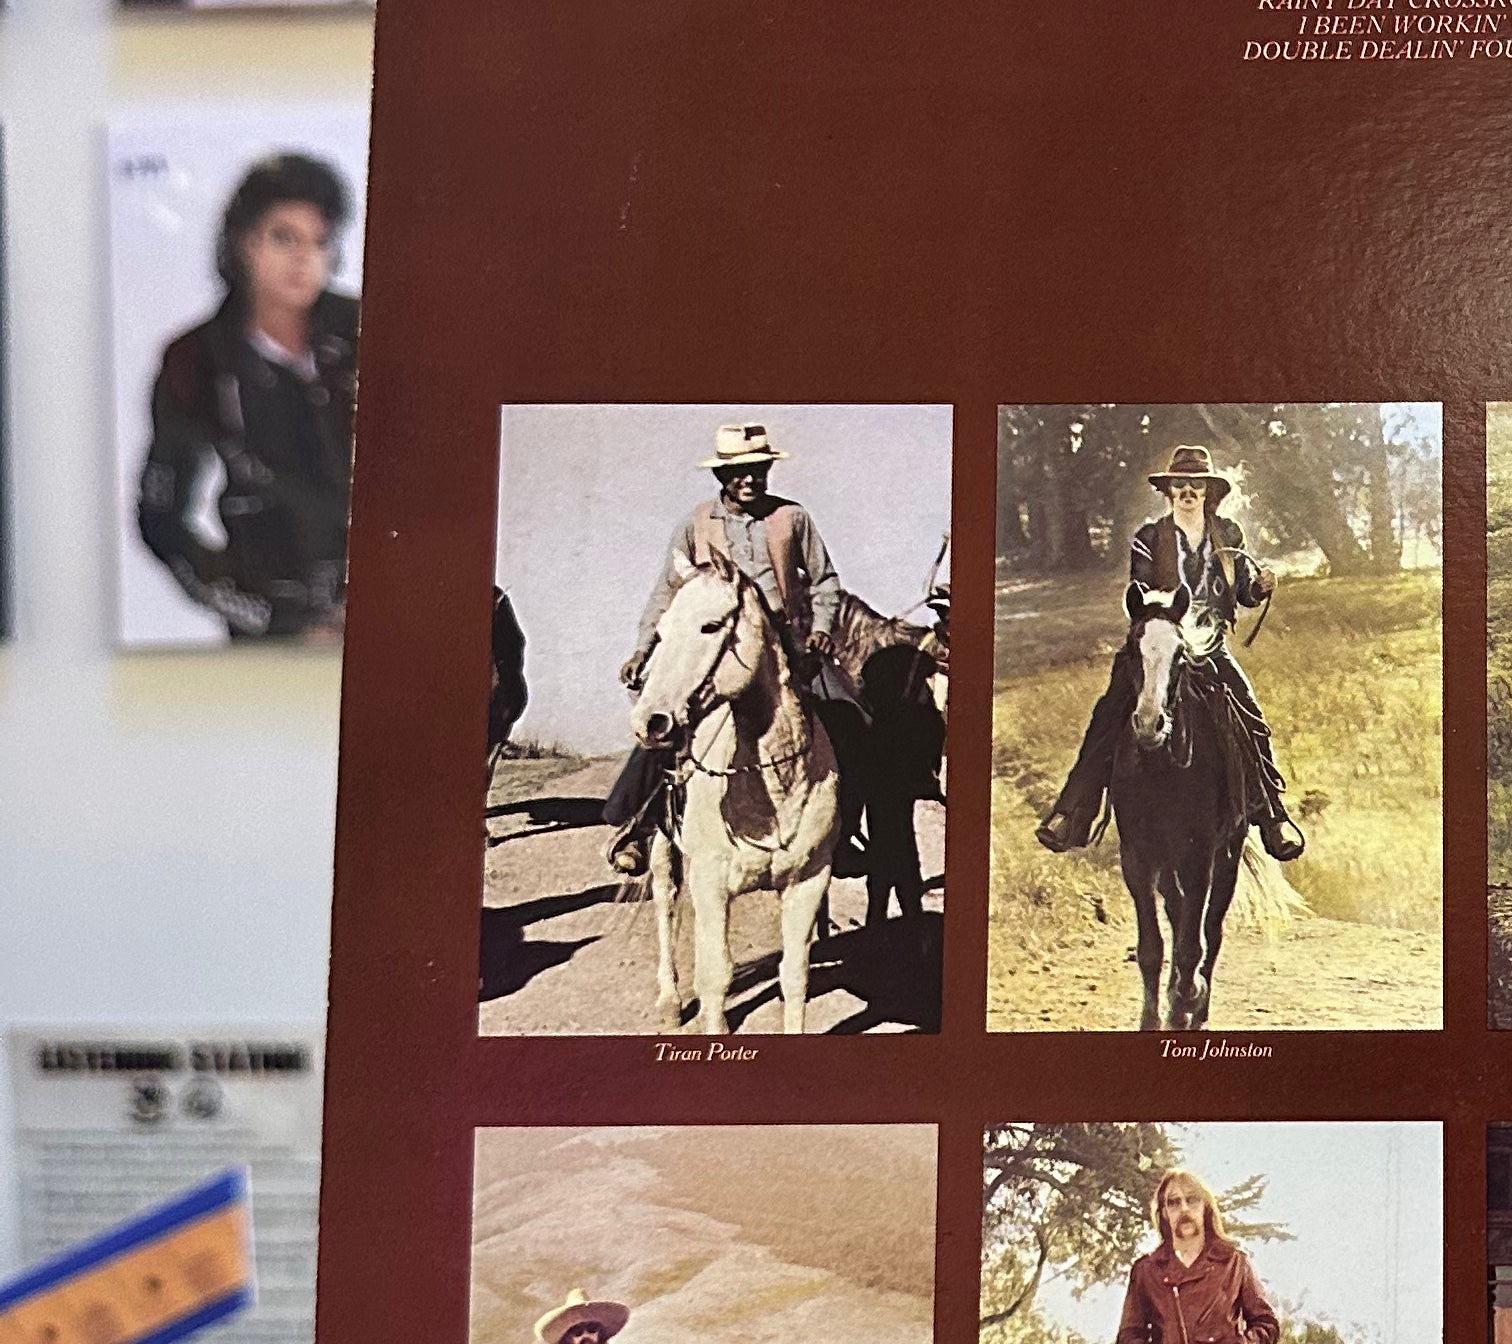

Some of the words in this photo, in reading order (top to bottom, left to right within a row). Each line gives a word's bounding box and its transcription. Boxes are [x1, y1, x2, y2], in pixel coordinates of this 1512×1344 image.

[1299, 16, 1307, 34] I
[1314, 16, 1385, 34] BEEN
[1243, 41, 1352, 60] DOUBLE
[656, 1043, 701, 1060] Tiran
[707, 1043, 758, 1060] Porter
[1161, 1039, 1196, 1057] Tom
[1199, 1039, 1272, 1060] Johnston
